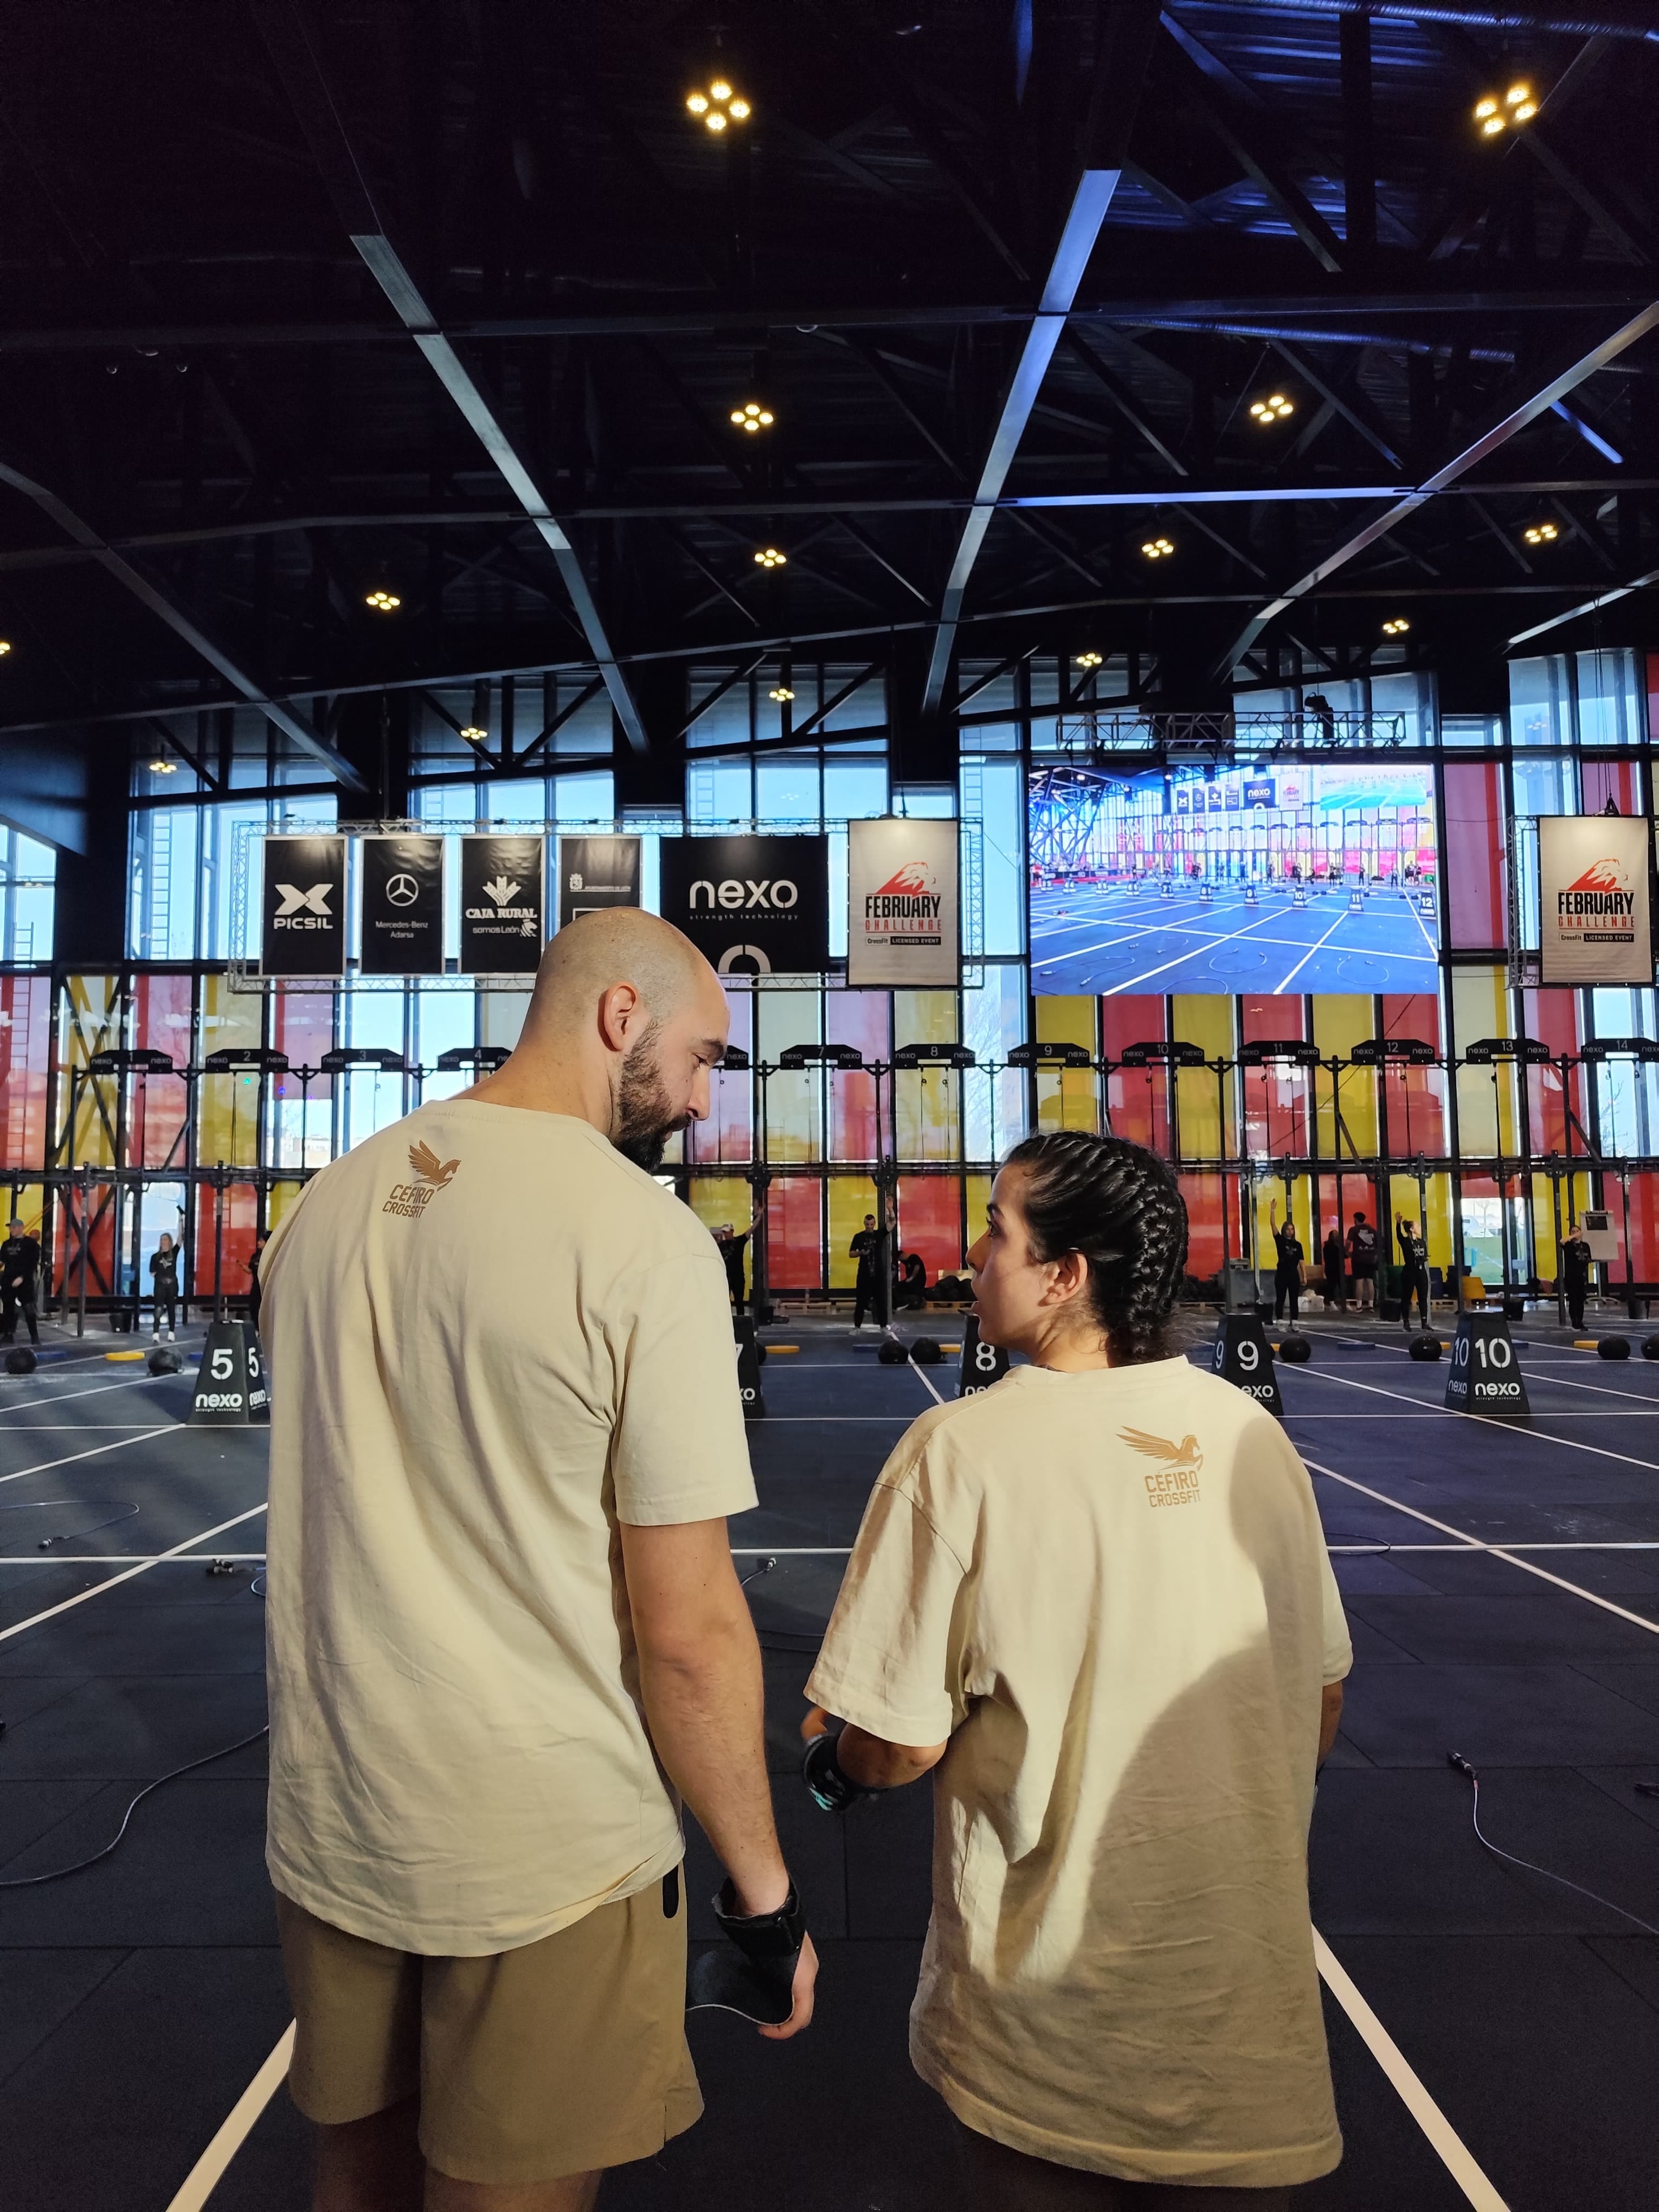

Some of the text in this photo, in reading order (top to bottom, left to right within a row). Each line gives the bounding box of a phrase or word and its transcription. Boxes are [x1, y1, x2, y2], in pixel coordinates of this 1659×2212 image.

[1248, 788, 1270, 798] nexo
[689, 879, 798, 909] nexo
[1295, 891, 1303, 900] 10
[1352, 893, 1360, 903] 11
[865, 896, 941, 918] FEBRUARY
[1422, 897, 1433, 908] 12
[1558, 892, 1634, 915] FEBRUARY
[465, 908, 538, 918] CAJA RURAL
[273, 917, 333, 929] PICSIL
[865, 919, 941, 930] CHALLENGE
[1558, 916, 1635, 928] CHALLENGE
[501, 925, 520, 934] León
[1044, 1045, 1052, 1056] 9
[1157, 1044, 1169, 1054] 10
[1274, 1043, 1283, 1053] 11
[1387, 1042, 1399, 1053] 12
[1501, 1041, 1514, 1052] 13
[1616, 1039, 1628, 1051] 14
[244, 1051, 250, 1062] 2
[360, 1050, 366, 1062] 3
[474, 1049, 481, 1060] 4
[818, 1047, 825, 1057] 7
[930, 1046, 938, 1057] 8
[389, 1184, 435, 1205] CÉFIRO
[382, 1200, 426, 1218] CROSSFIT
[976, 1341, 996, 1371] 8
[1216, 1340, 1224, 1369] 9
[1237, 1340, 1258, 1371] 9
[1455, 1337, 1469, 1367] 10
[1475, 1338, 1510, 1368] 10
[210, 1348, 233, 1380] 5
[248, 1347, 259, 1378] 5
[1241, 1385, 1274, 1398] exo
[1448, 1379, 1468, 1394] nexo
[1475, 1382, 1520, 1396] nexo
[195, 1393, 243, 1408] nexo
[249, 1389, 266, 1406] nexo
[1149, 1489, 1201, 1508] CROSSFIT
